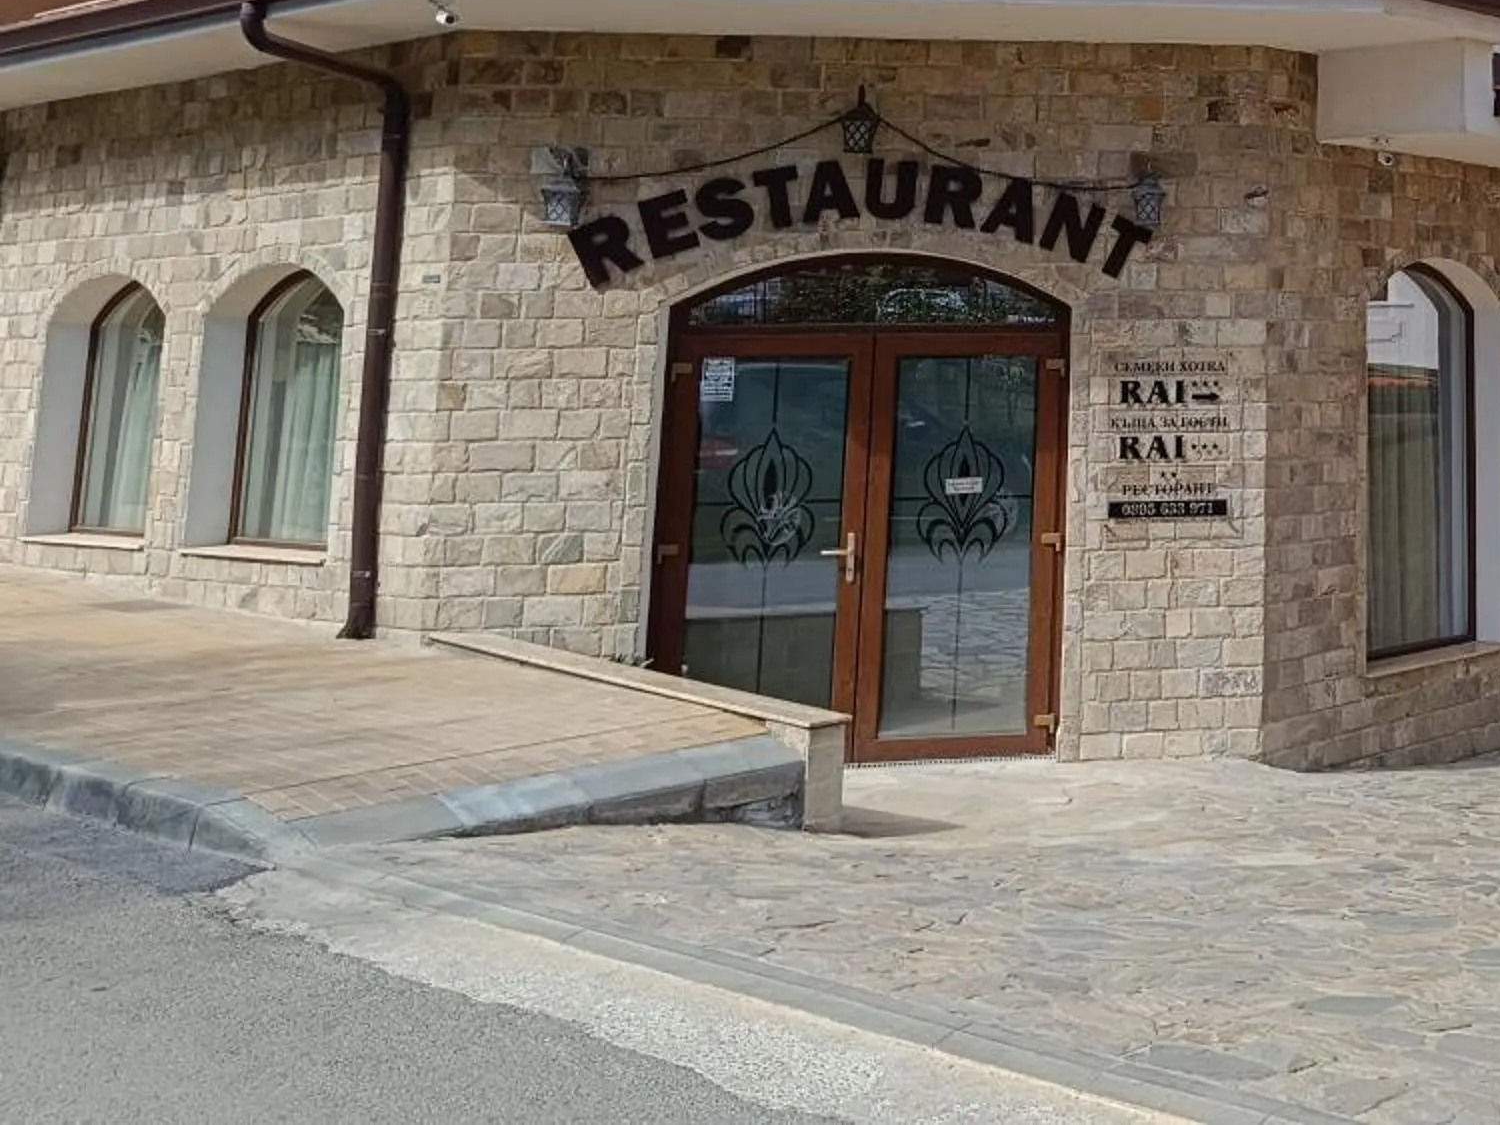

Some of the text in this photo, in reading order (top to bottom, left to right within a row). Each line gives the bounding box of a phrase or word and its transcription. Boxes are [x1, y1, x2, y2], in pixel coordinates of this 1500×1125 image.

[569, 158, 1152, 288] RESTAURANT
[1120, 380, 1185, 404] RAI
[1119, 436, 1185, 460] RAI
